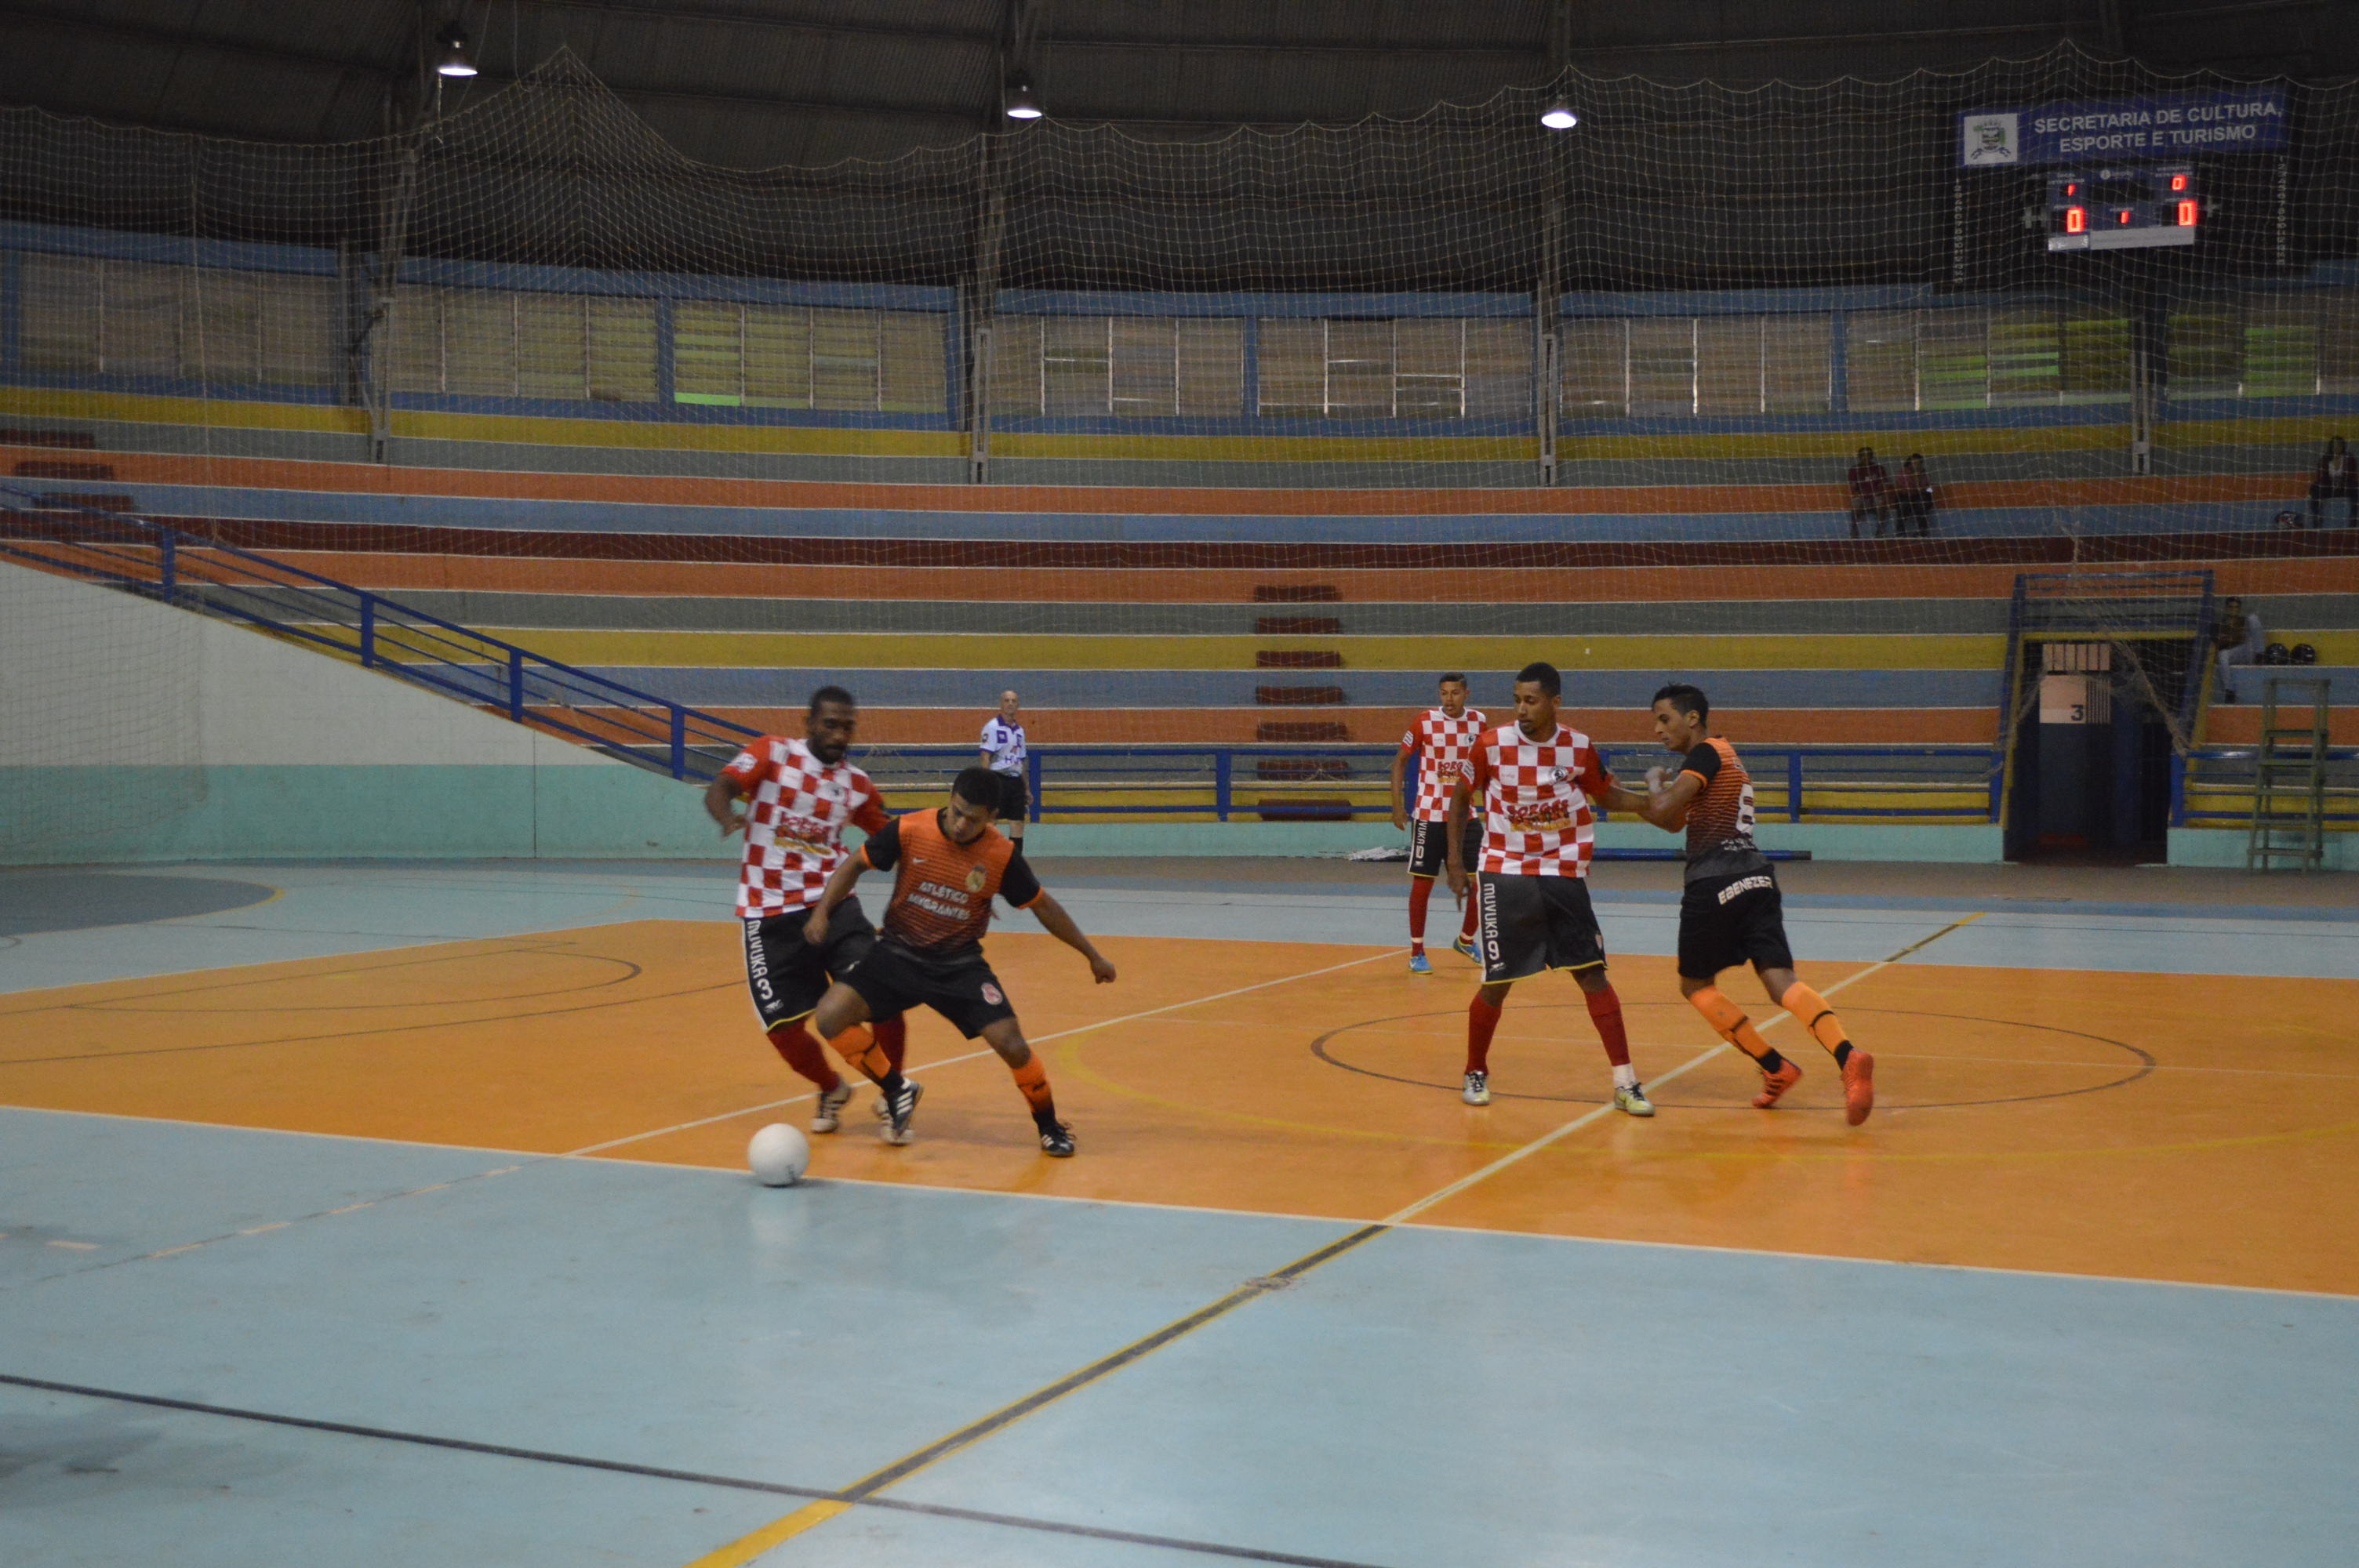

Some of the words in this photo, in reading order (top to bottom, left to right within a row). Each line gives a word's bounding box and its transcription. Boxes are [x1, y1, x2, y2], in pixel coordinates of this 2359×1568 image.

[2034, 111, 2150, 133] SECRETARIA
[2156, 109, 2181, 124] DE
[2187, 102, 2282, 122] CULTURA,
[2060, 132, 2146, 153] ESPORTE
[2152, 132, 2164, 146] E
[2169, 125, 2255, 144] TURISMO
[2172, 175, 2186, 191] 0
[2066, 207, 2085, 233] 0
[2178, 201, 2196, 226] 0
[2070, 704, 2084, 720] 3
[1717, 875, 1773, 905] EBENEZER
[1484, 883, 1499, 938] MUVUKA
[747, 920, 768, 979] MUVUKA
[1488, 940, 1499, 960] 9
[757, 978, 773, 1000] 3
